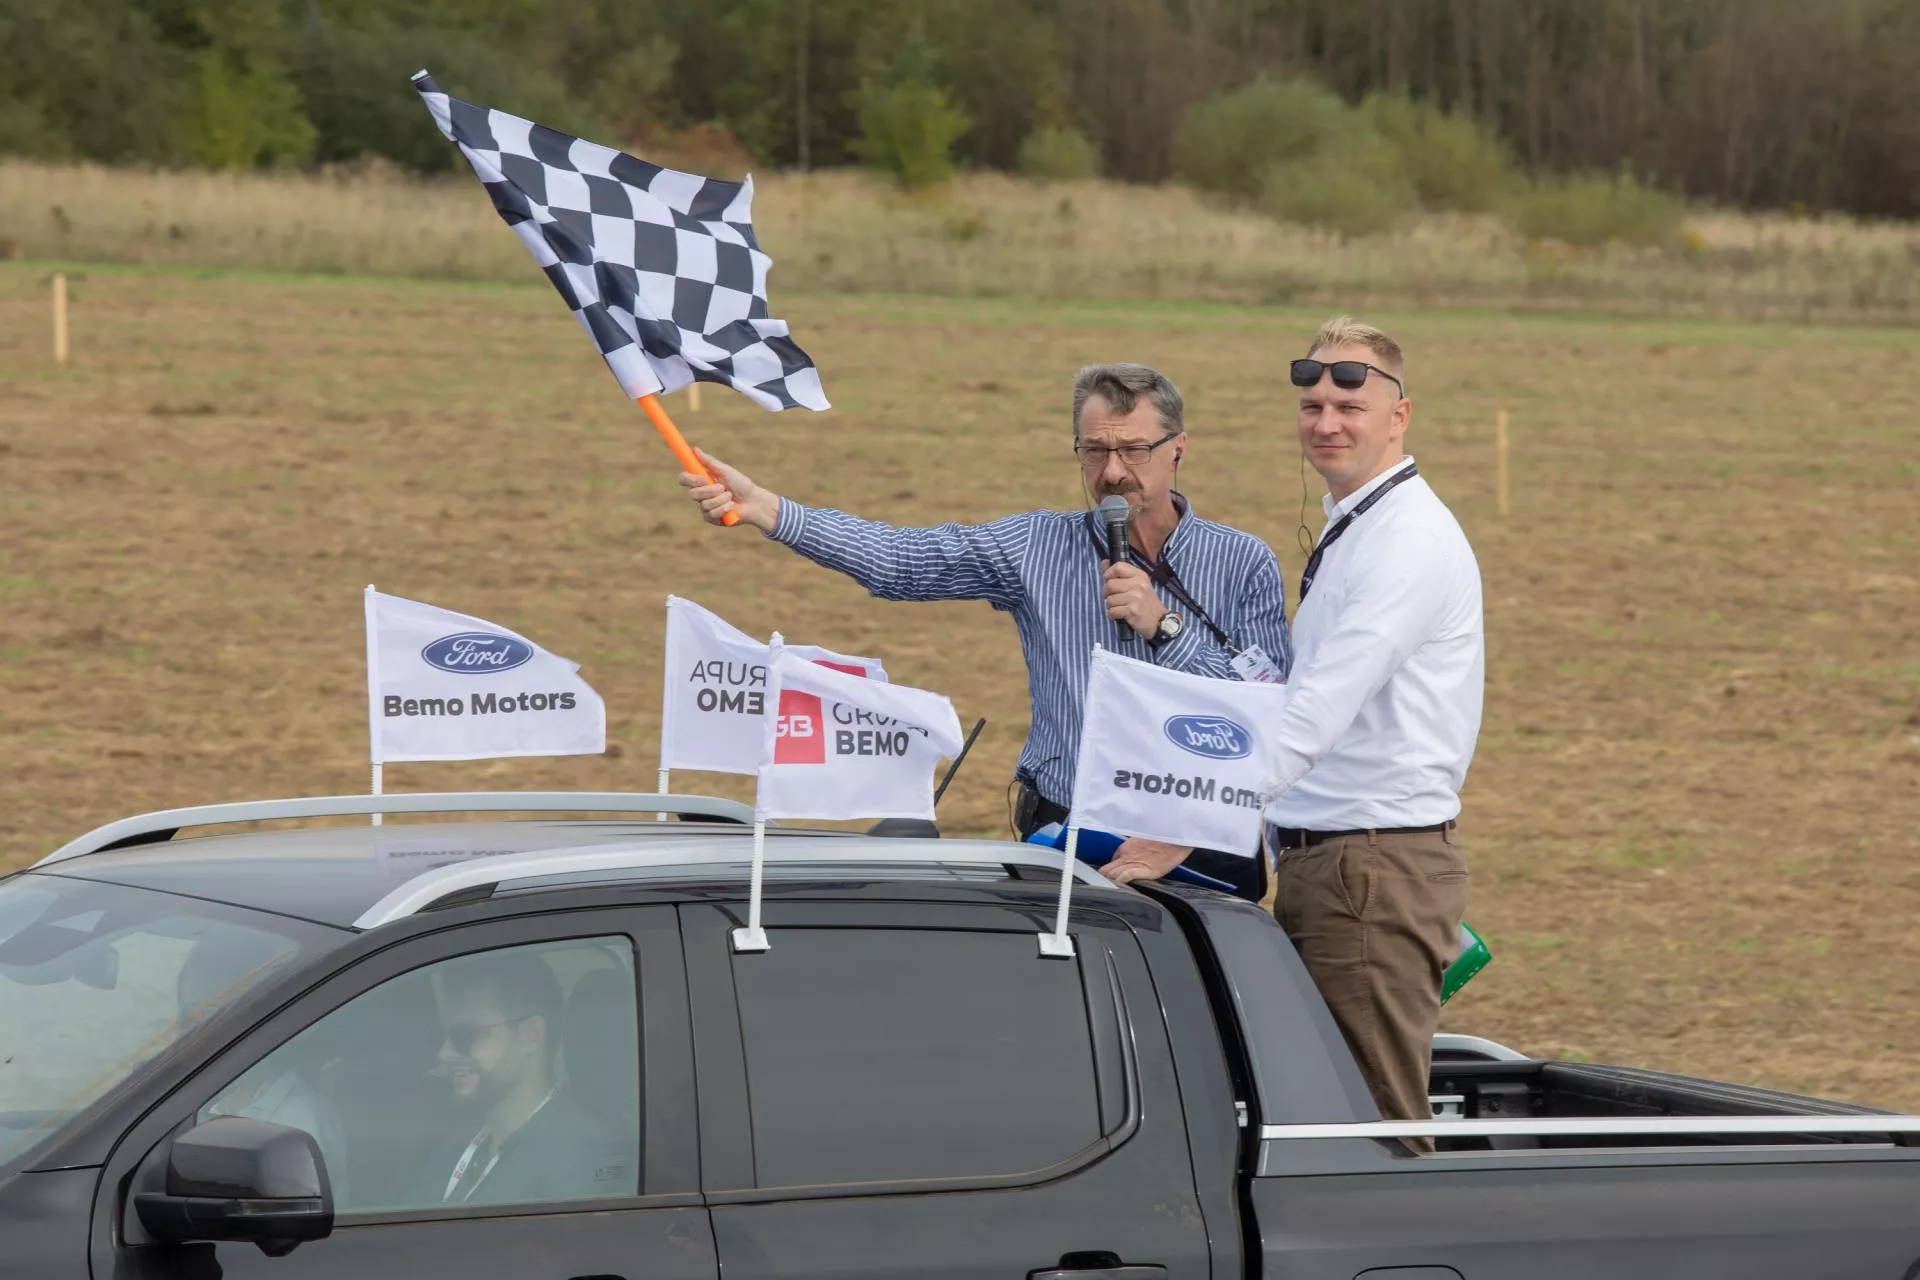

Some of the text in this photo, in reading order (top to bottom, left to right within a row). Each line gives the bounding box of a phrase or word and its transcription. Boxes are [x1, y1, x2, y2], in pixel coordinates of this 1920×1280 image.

[444, 638, 511, 665] Ford
[384, 691, 576, 717] Bemo Motors
[835, 730, 910, 756] BEMO
